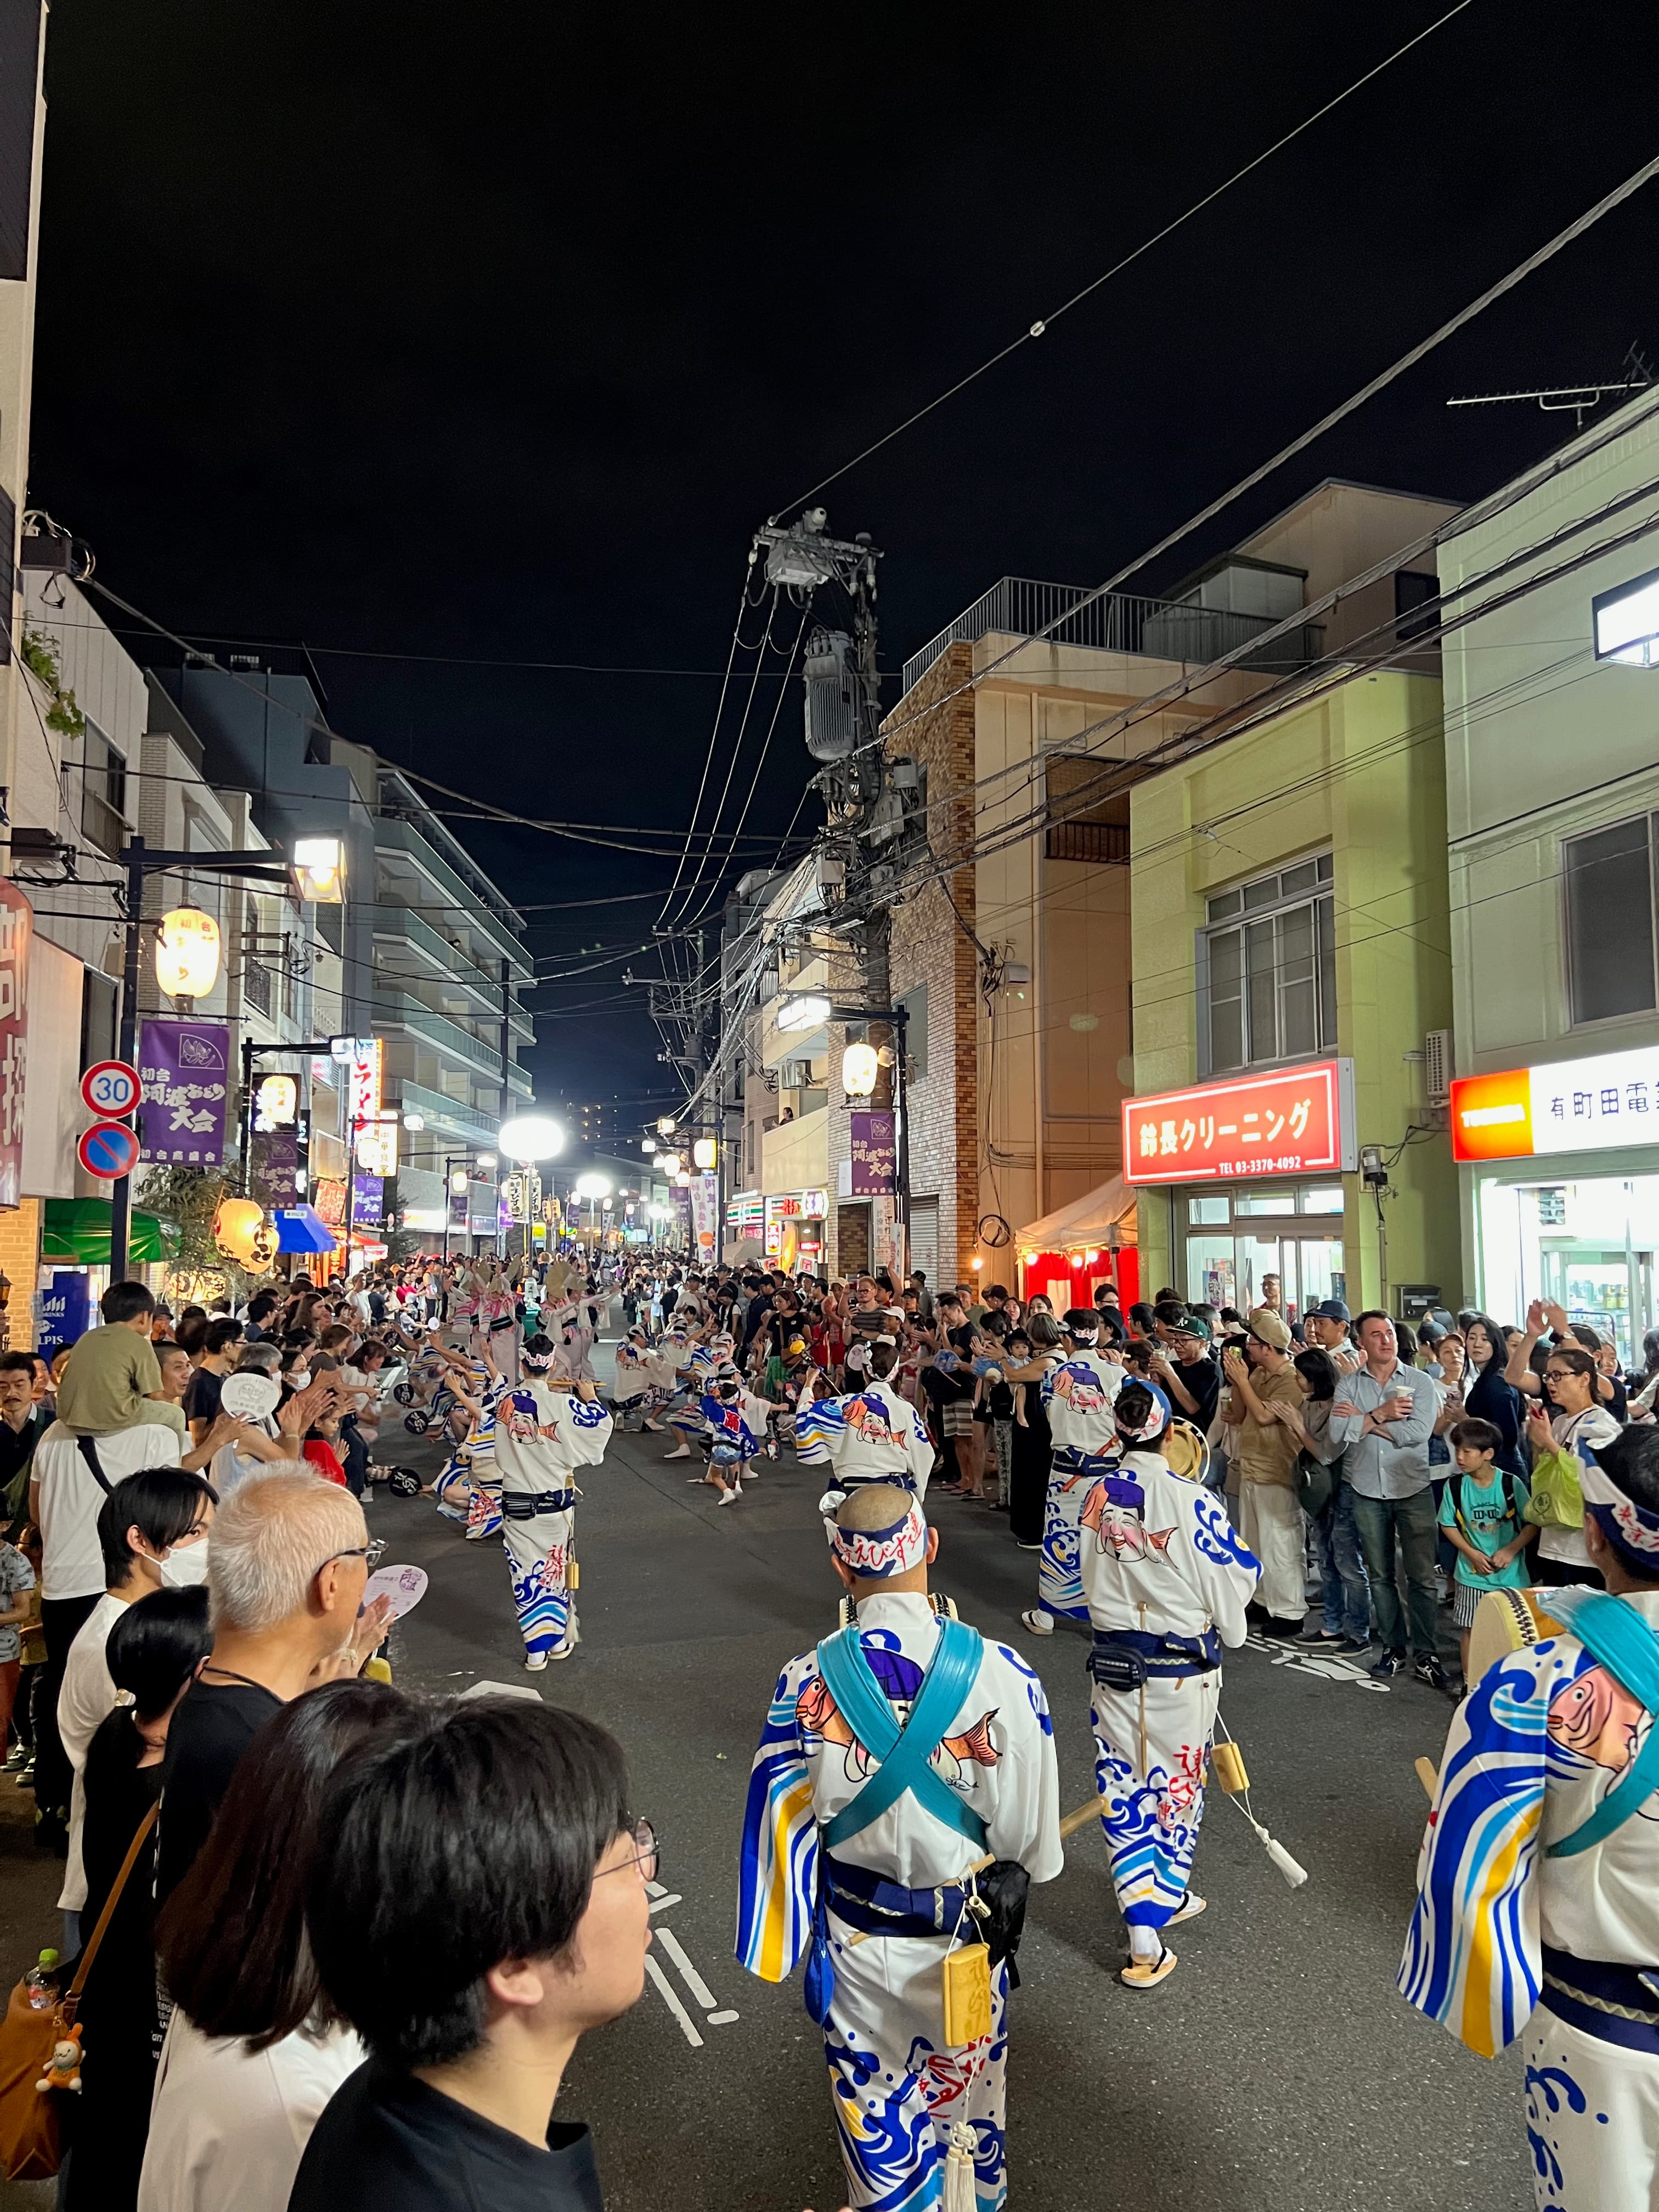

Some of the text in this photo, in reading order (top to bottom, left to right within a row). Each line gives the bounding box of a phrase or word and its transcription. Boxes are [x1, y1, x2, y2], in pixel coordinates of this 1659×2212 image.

[141, 1067, 170, 1082] 初台
[96, 1077, 129, 1102] 30
[141, 1082, 226, 1108] 阿波おどり
[353, 1062, 371, 1132] ラーメン
[169, 1106, 218, 1133] 大会
[1139, 1098, 1312, 1157] 鈴長クリーニング
[380, 1132, 390, 1174] 中華食堂
[1219, 1155, 1301, 1175] TEL 03-3370-4092
[868, 1161, 894, 1177] 大会
[268, 1179, 294, 1193] 大会
[39, 1336, 64, 1345] LPIS
